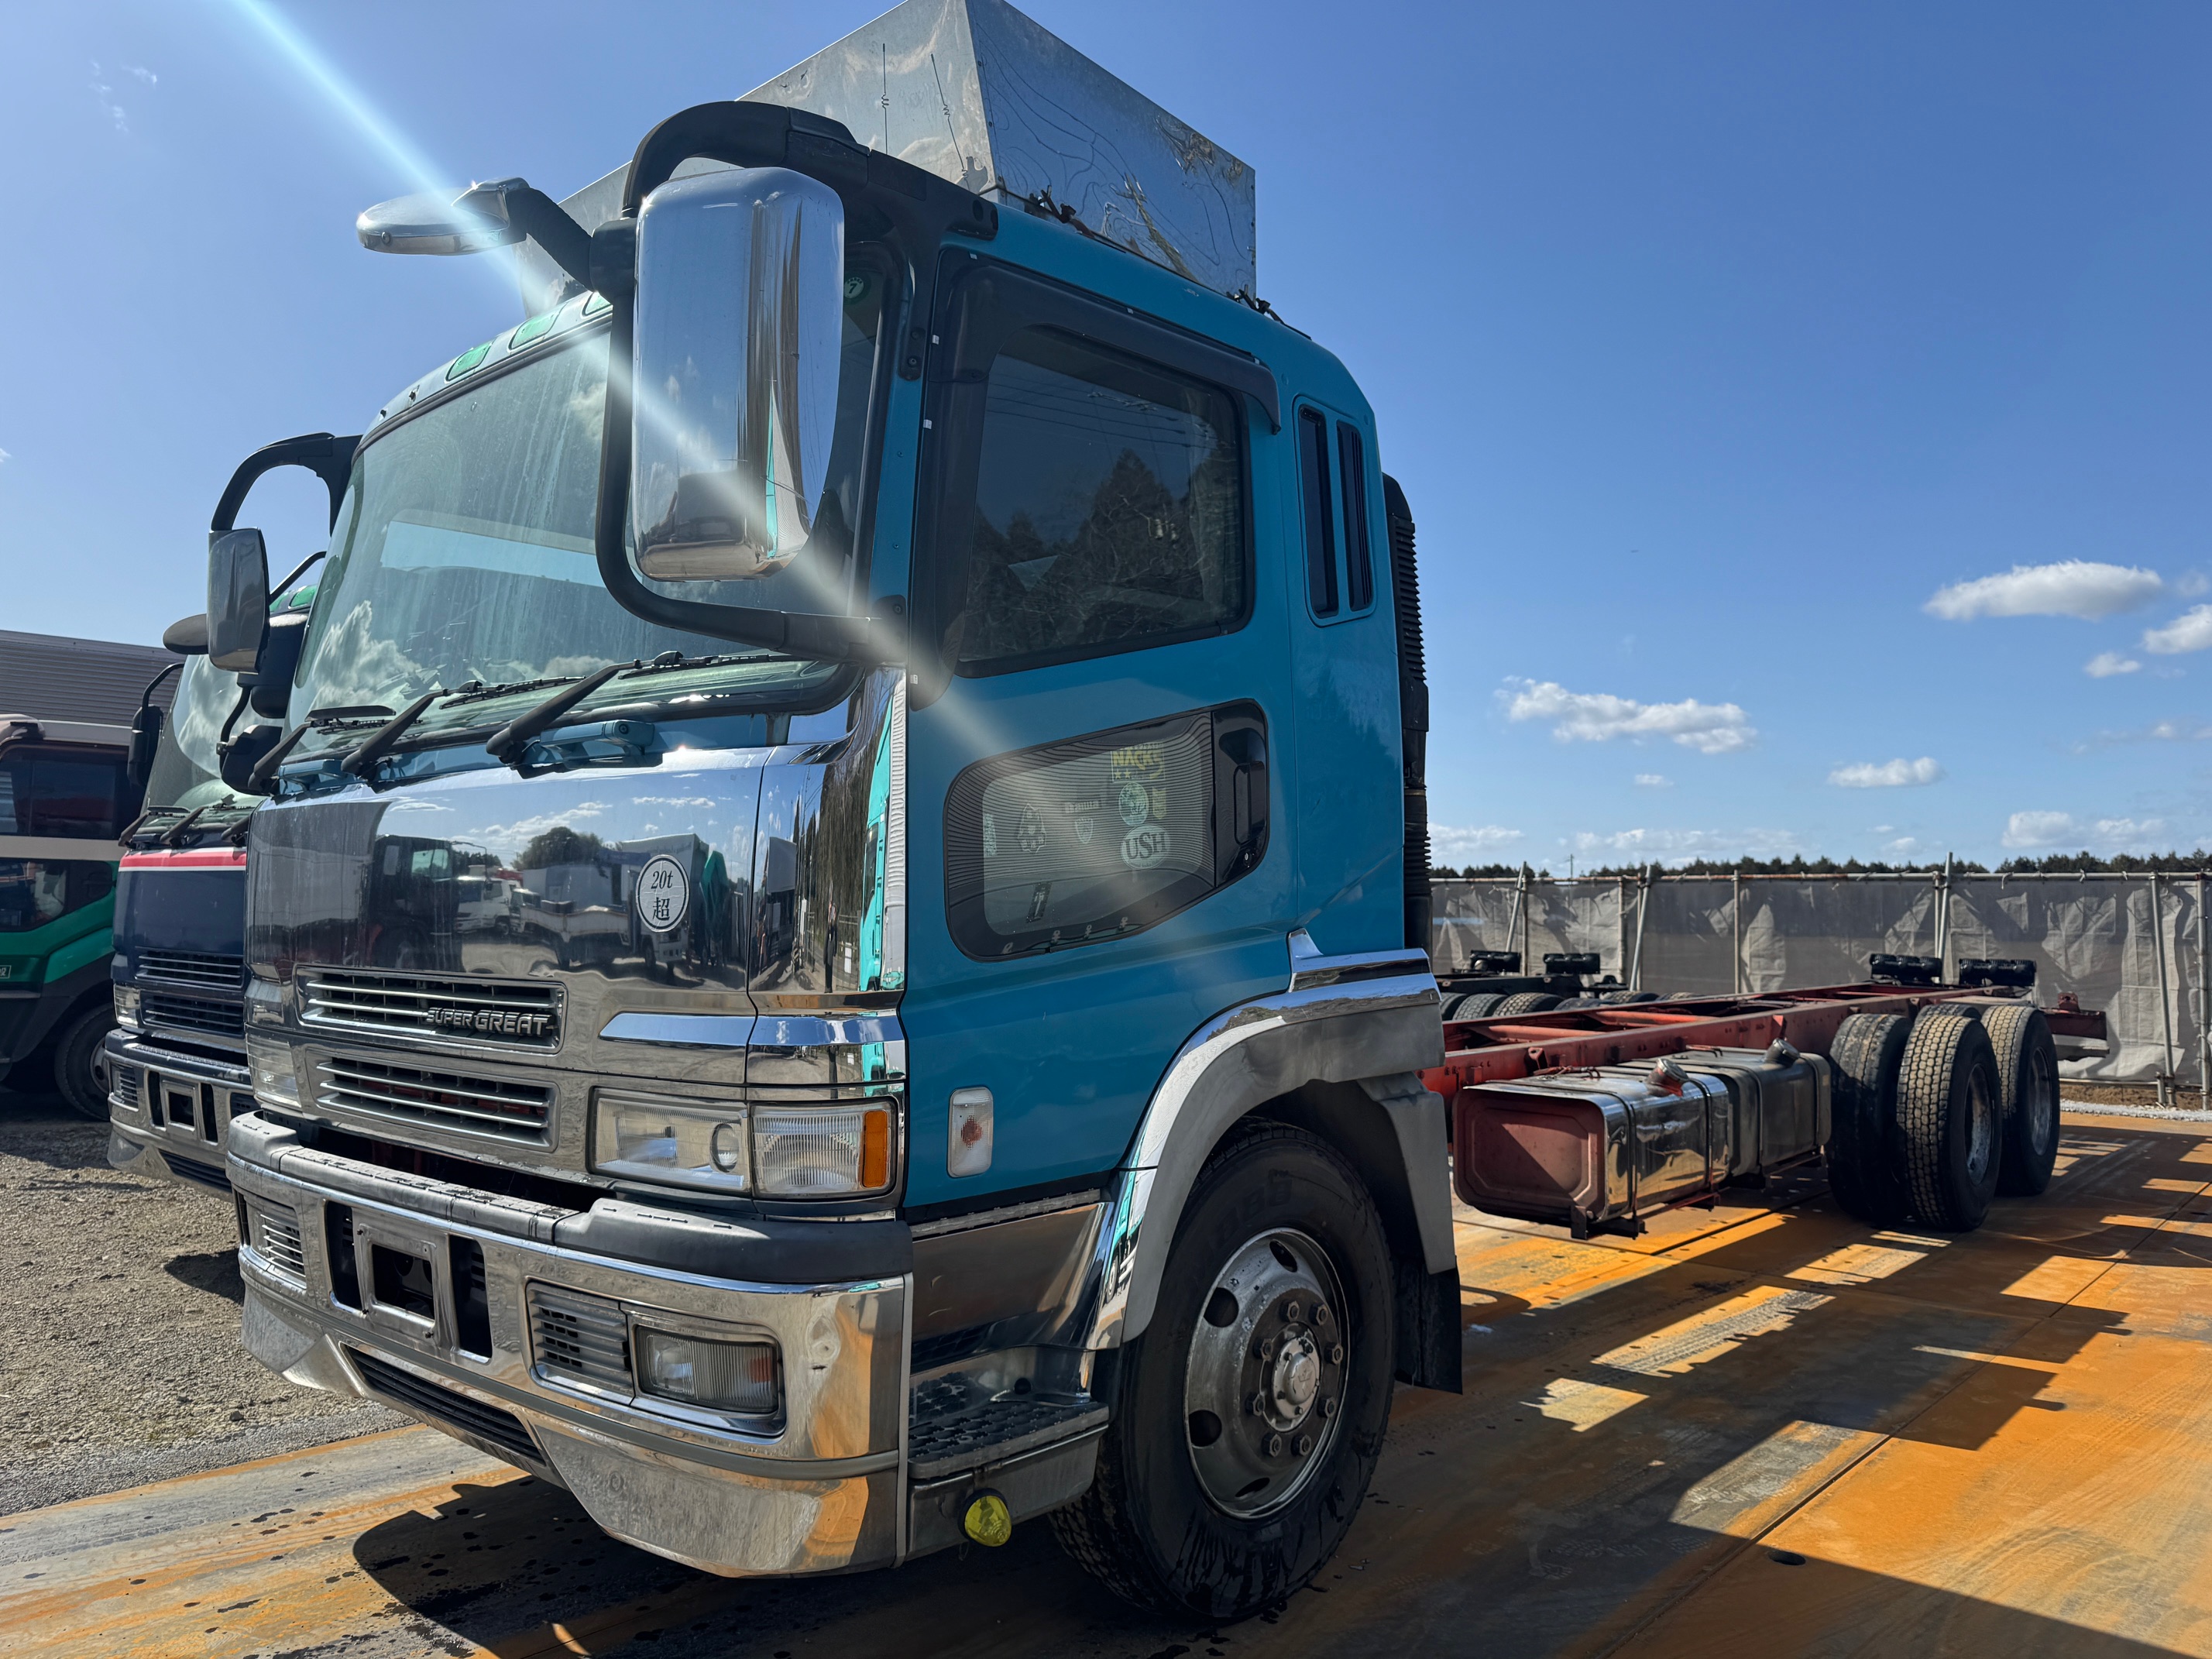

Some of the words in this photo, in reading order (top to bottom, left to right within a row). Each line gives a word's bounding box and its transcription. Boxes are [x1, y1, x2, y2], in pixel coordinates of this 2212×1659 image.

[1125, 831, 1167, 860] USH
[651, 870, 674, 889] 20t
[652, 897, 671, 922] 超
[426, 1007, 476, 1028] SUPER
[475, 1009, 551, 1036] GREAT
